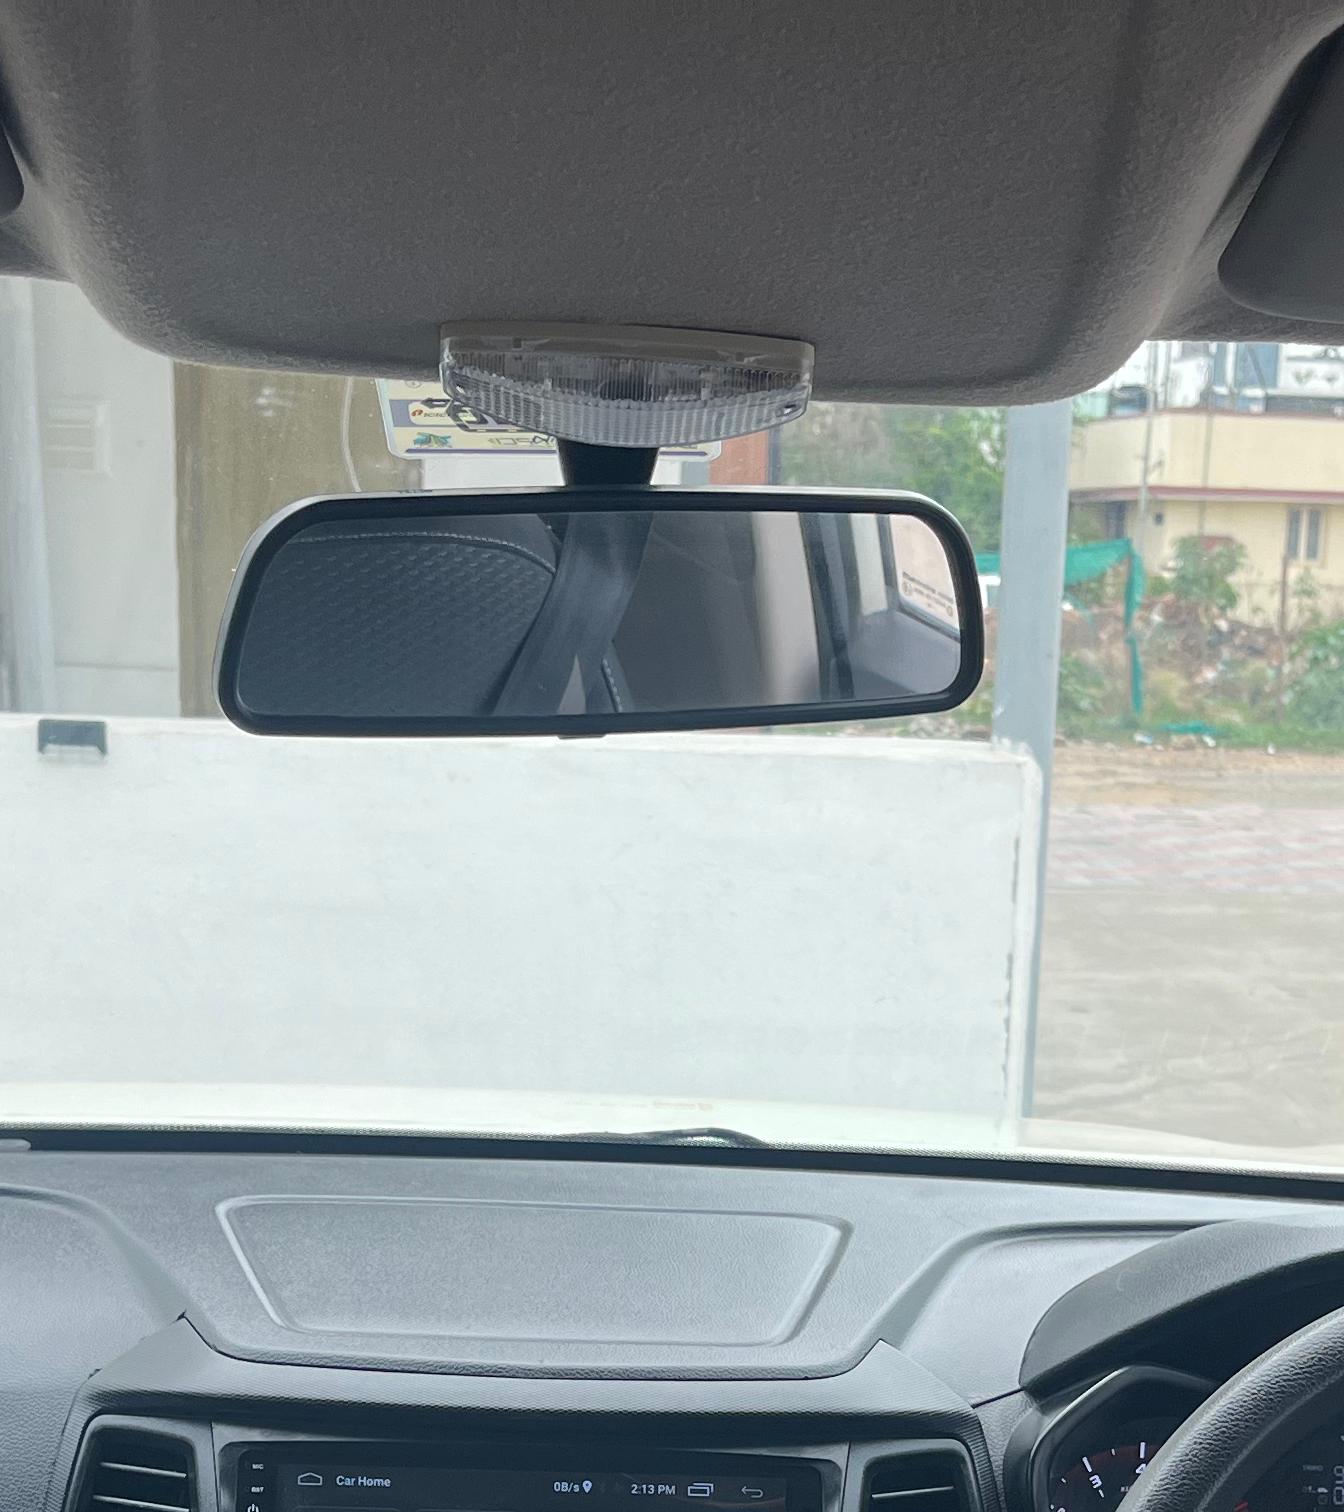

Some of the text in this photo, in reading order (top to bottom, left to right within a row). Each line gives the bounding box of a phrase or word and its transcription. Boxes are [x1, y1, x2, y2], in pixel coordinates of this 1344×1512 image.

[336, 1475, 391, 1487] Car Home
[553, 1481, 580, 1493] 0B/s
[1088, 1474, 1103, 1489] 3
[631, 1484, 676, 1495] 2:13 PM
